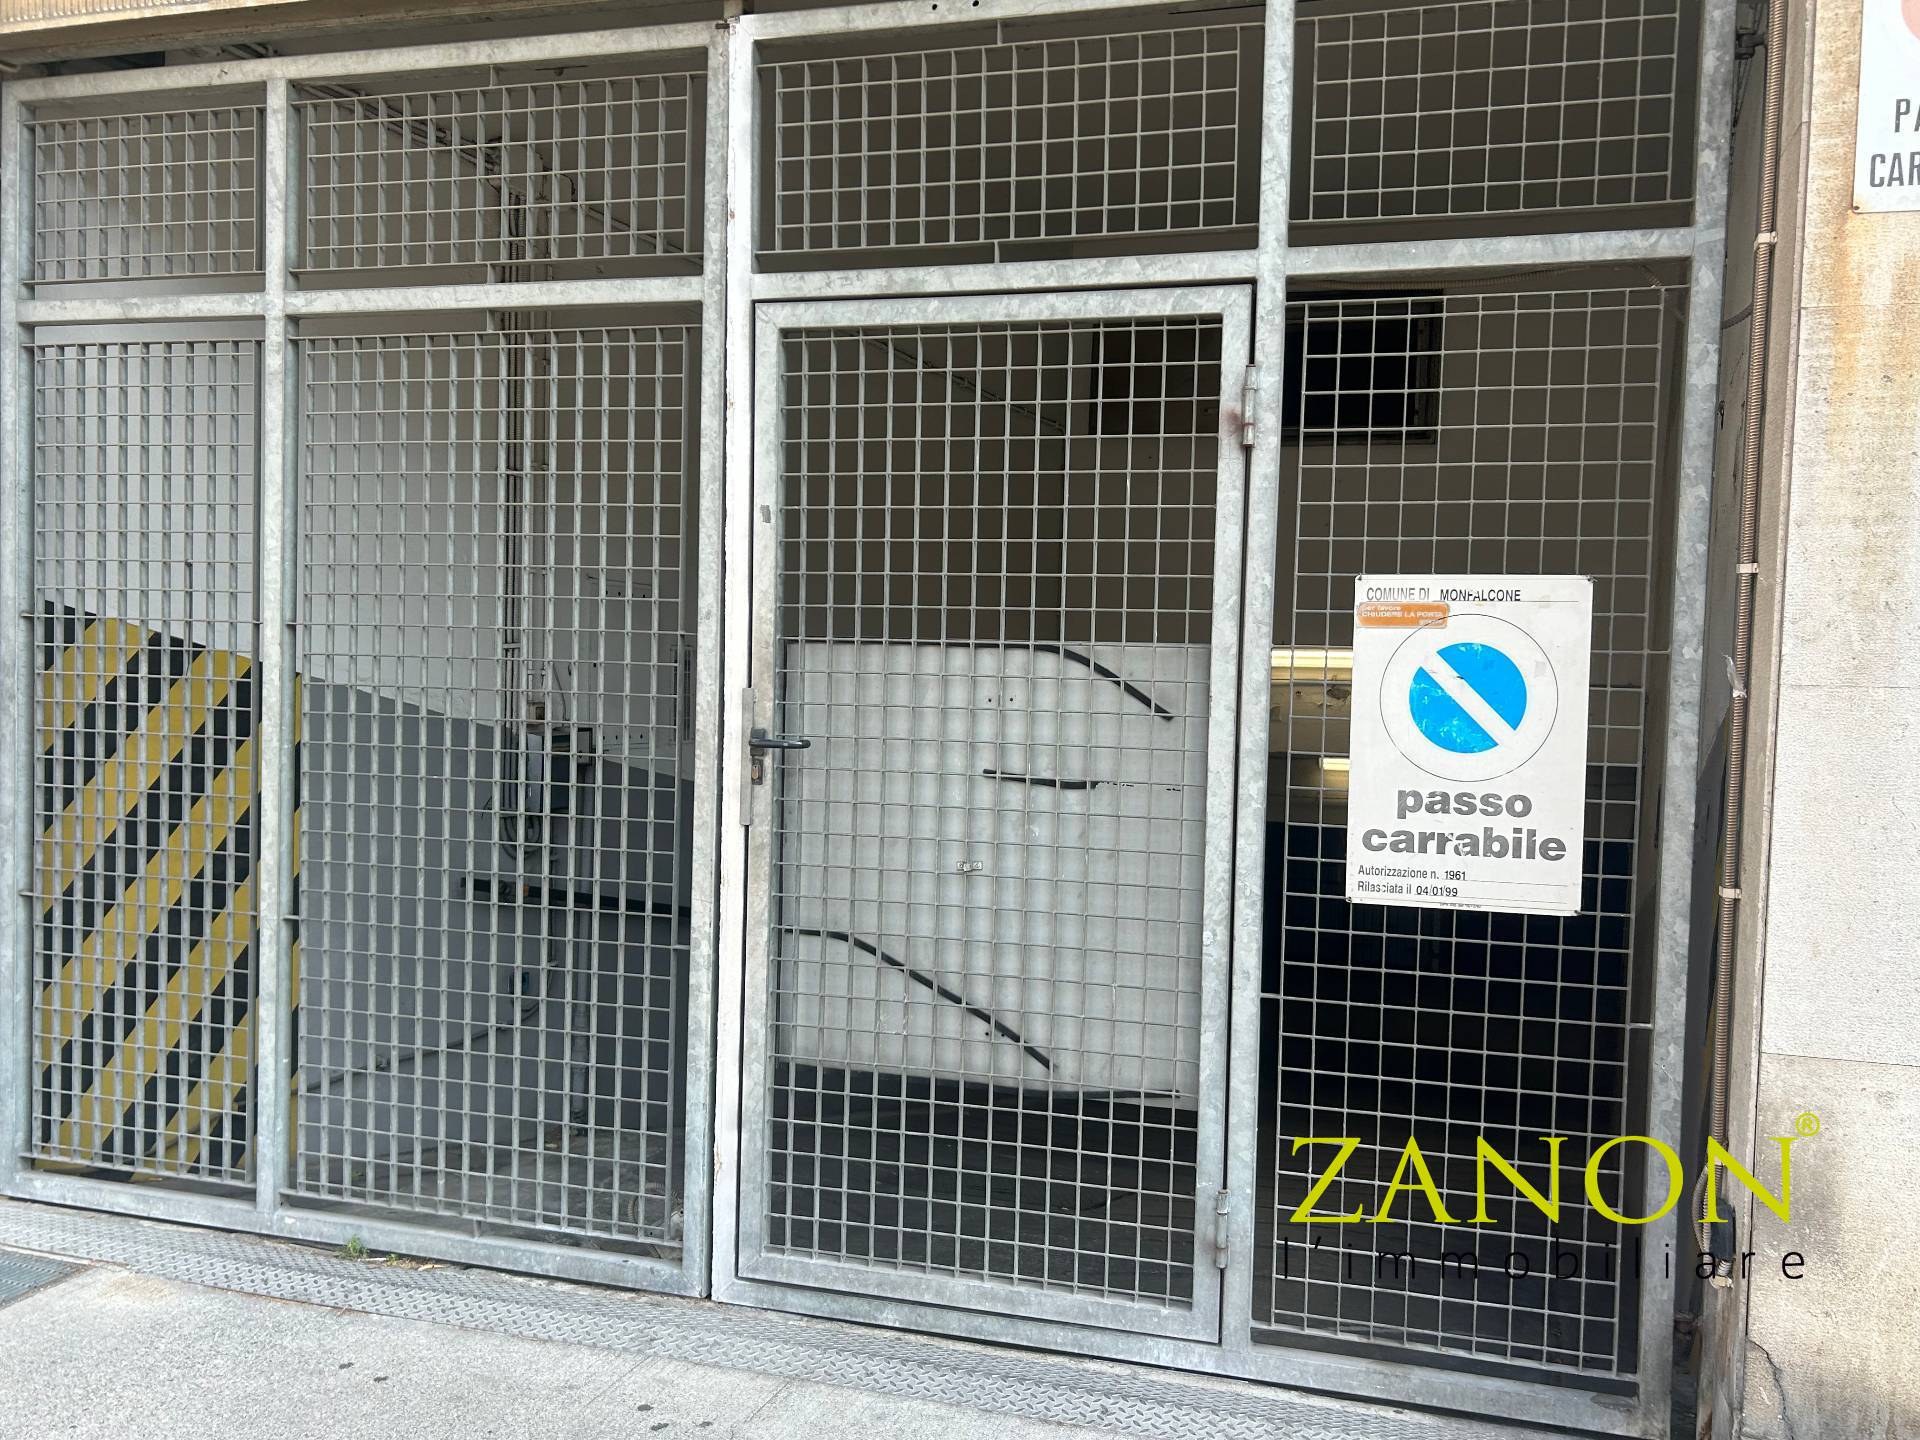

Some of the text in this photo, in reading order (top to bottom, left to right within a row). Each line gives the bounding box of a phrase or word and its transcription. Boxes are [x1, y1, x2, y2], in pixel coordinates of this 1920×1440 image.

[1366, 587, 1521, 602] COMUNE DI MONFALCONE
[1396, 789, 1533, 820] passo
[1361, 826, 1567, 862] carrabile
[1357, 864, 1466, 881] Autorizzazione n. 1961
[1357, 880, 1404, 895] Rilasciata
[1406, 883, 1412, 895] il
